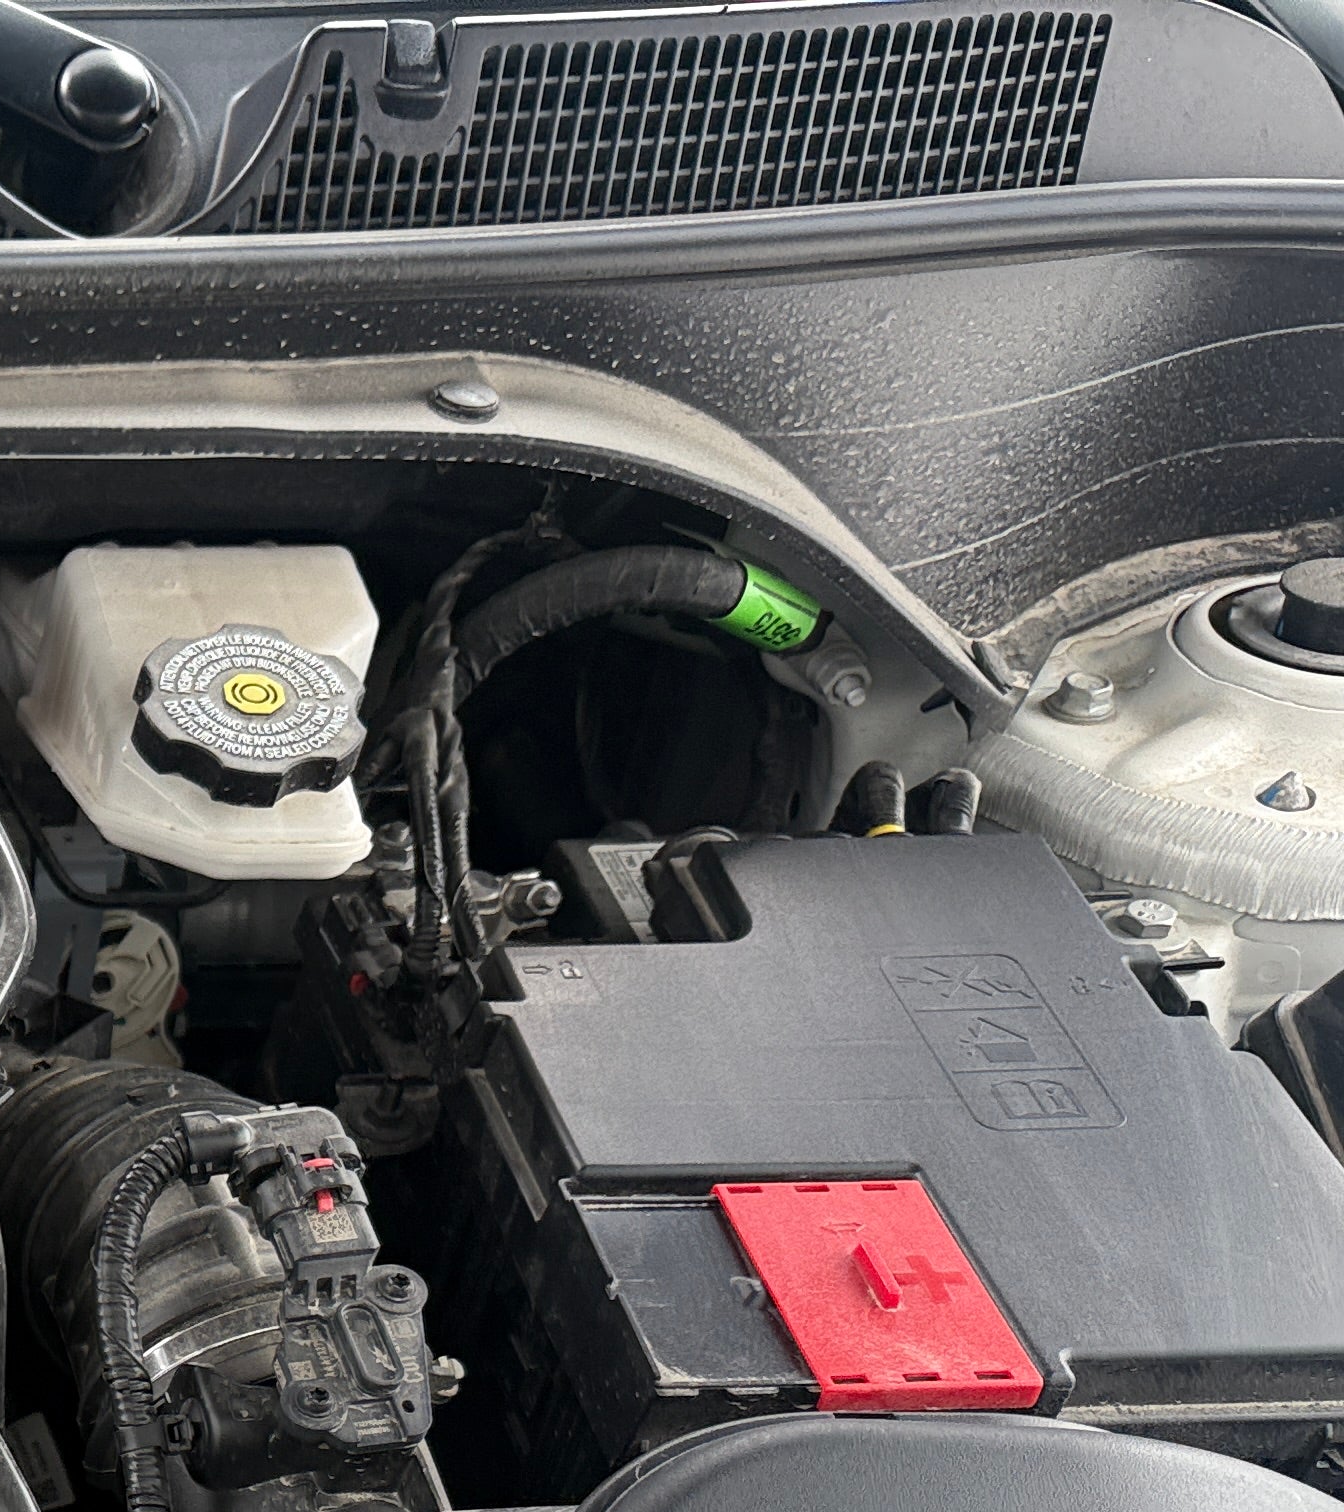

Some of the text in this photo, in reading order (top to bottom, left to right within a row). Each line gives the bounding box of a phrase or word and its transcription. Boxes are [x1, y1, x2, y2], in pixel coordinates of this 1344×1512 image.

[179, 698, 204, 717] CAP
[192, 713, 238, 741] BEFORE
[247, 720, 292, 734] CLEAN
[283, 702, 313, 728] FILLER
[179, 720, 217, 745] FLUID
[213, 737, 252, 757] FROM
[264, 741, 315, 758] SEALED
